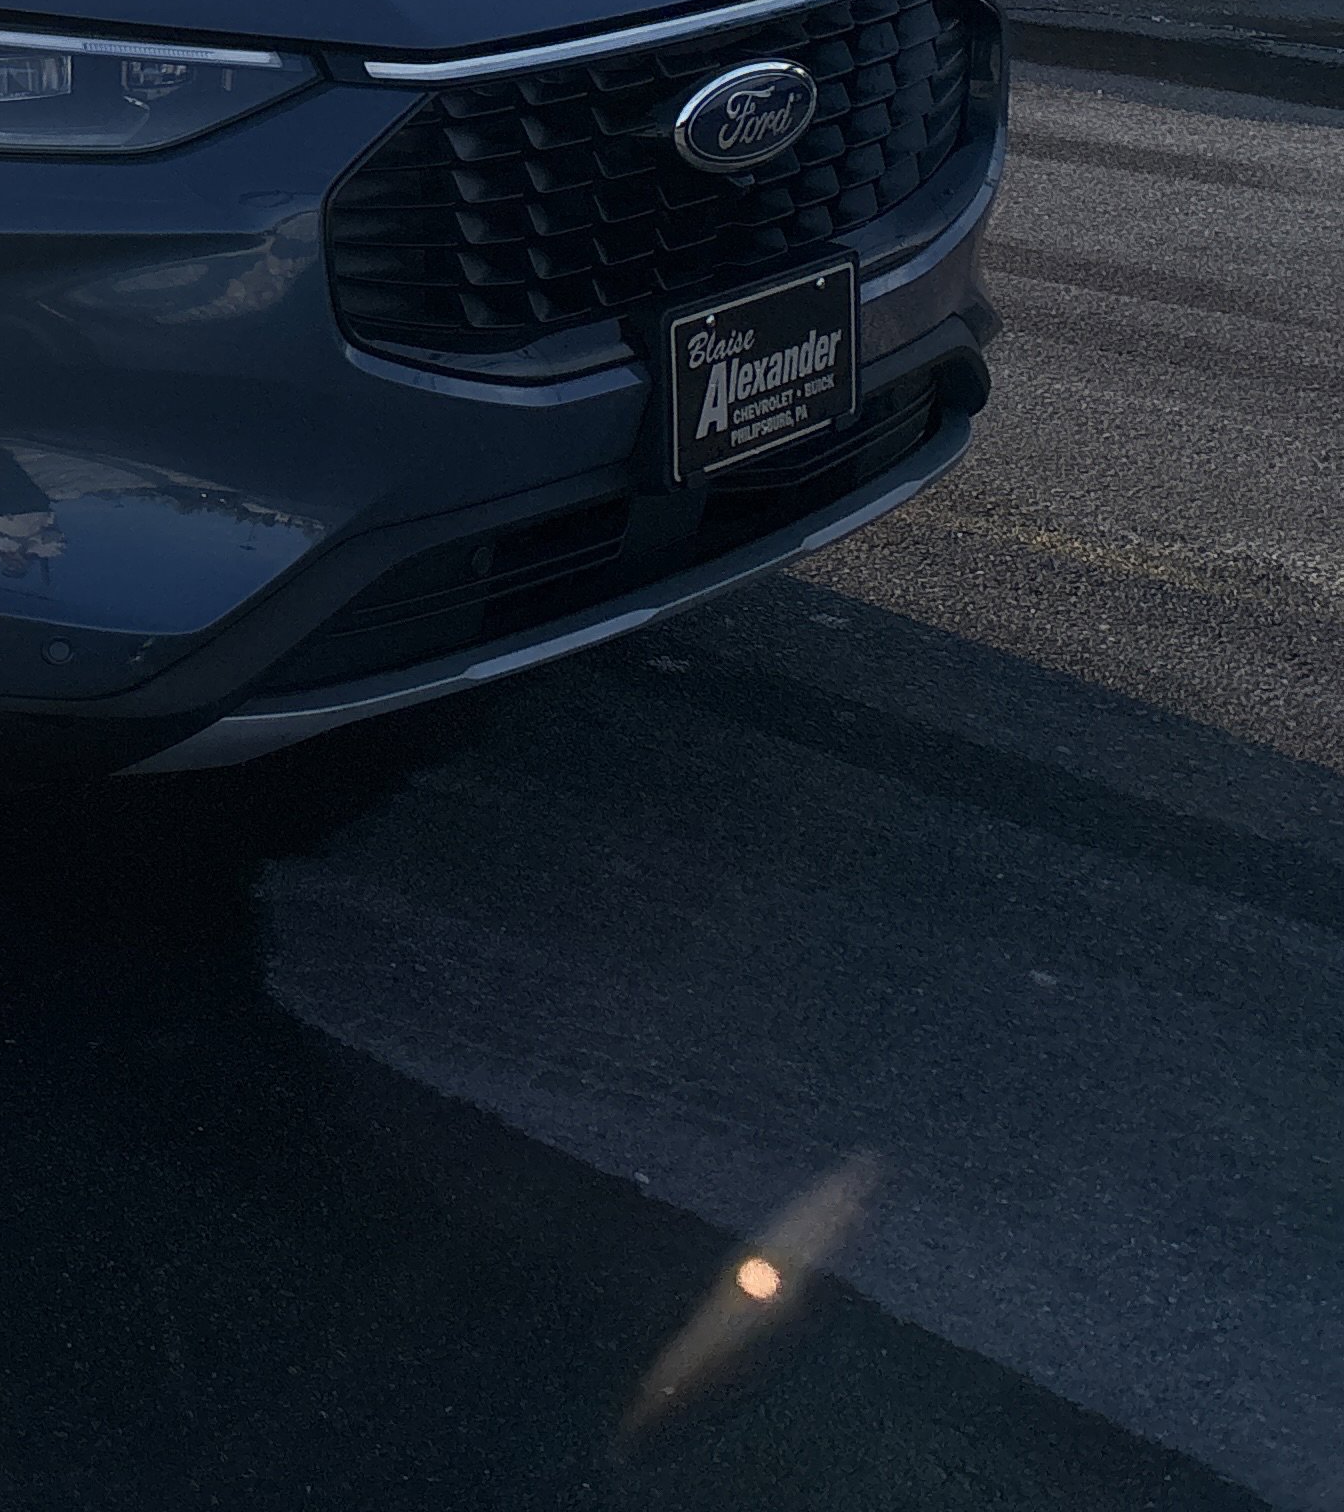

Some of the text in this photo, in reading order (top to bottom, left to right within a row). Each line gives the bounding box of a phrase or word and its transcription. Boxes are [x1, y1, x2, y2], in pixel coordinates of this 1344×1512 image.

[717, 86, 794, 151] Ford
[687, 328, 755, 369] Blaise
[696, 328, 842, 440] Alexander
[733, 373, 835, 424] CHEVROLET BUICK
[730, 404, 809, 448] PHILIPSBURG, PA
